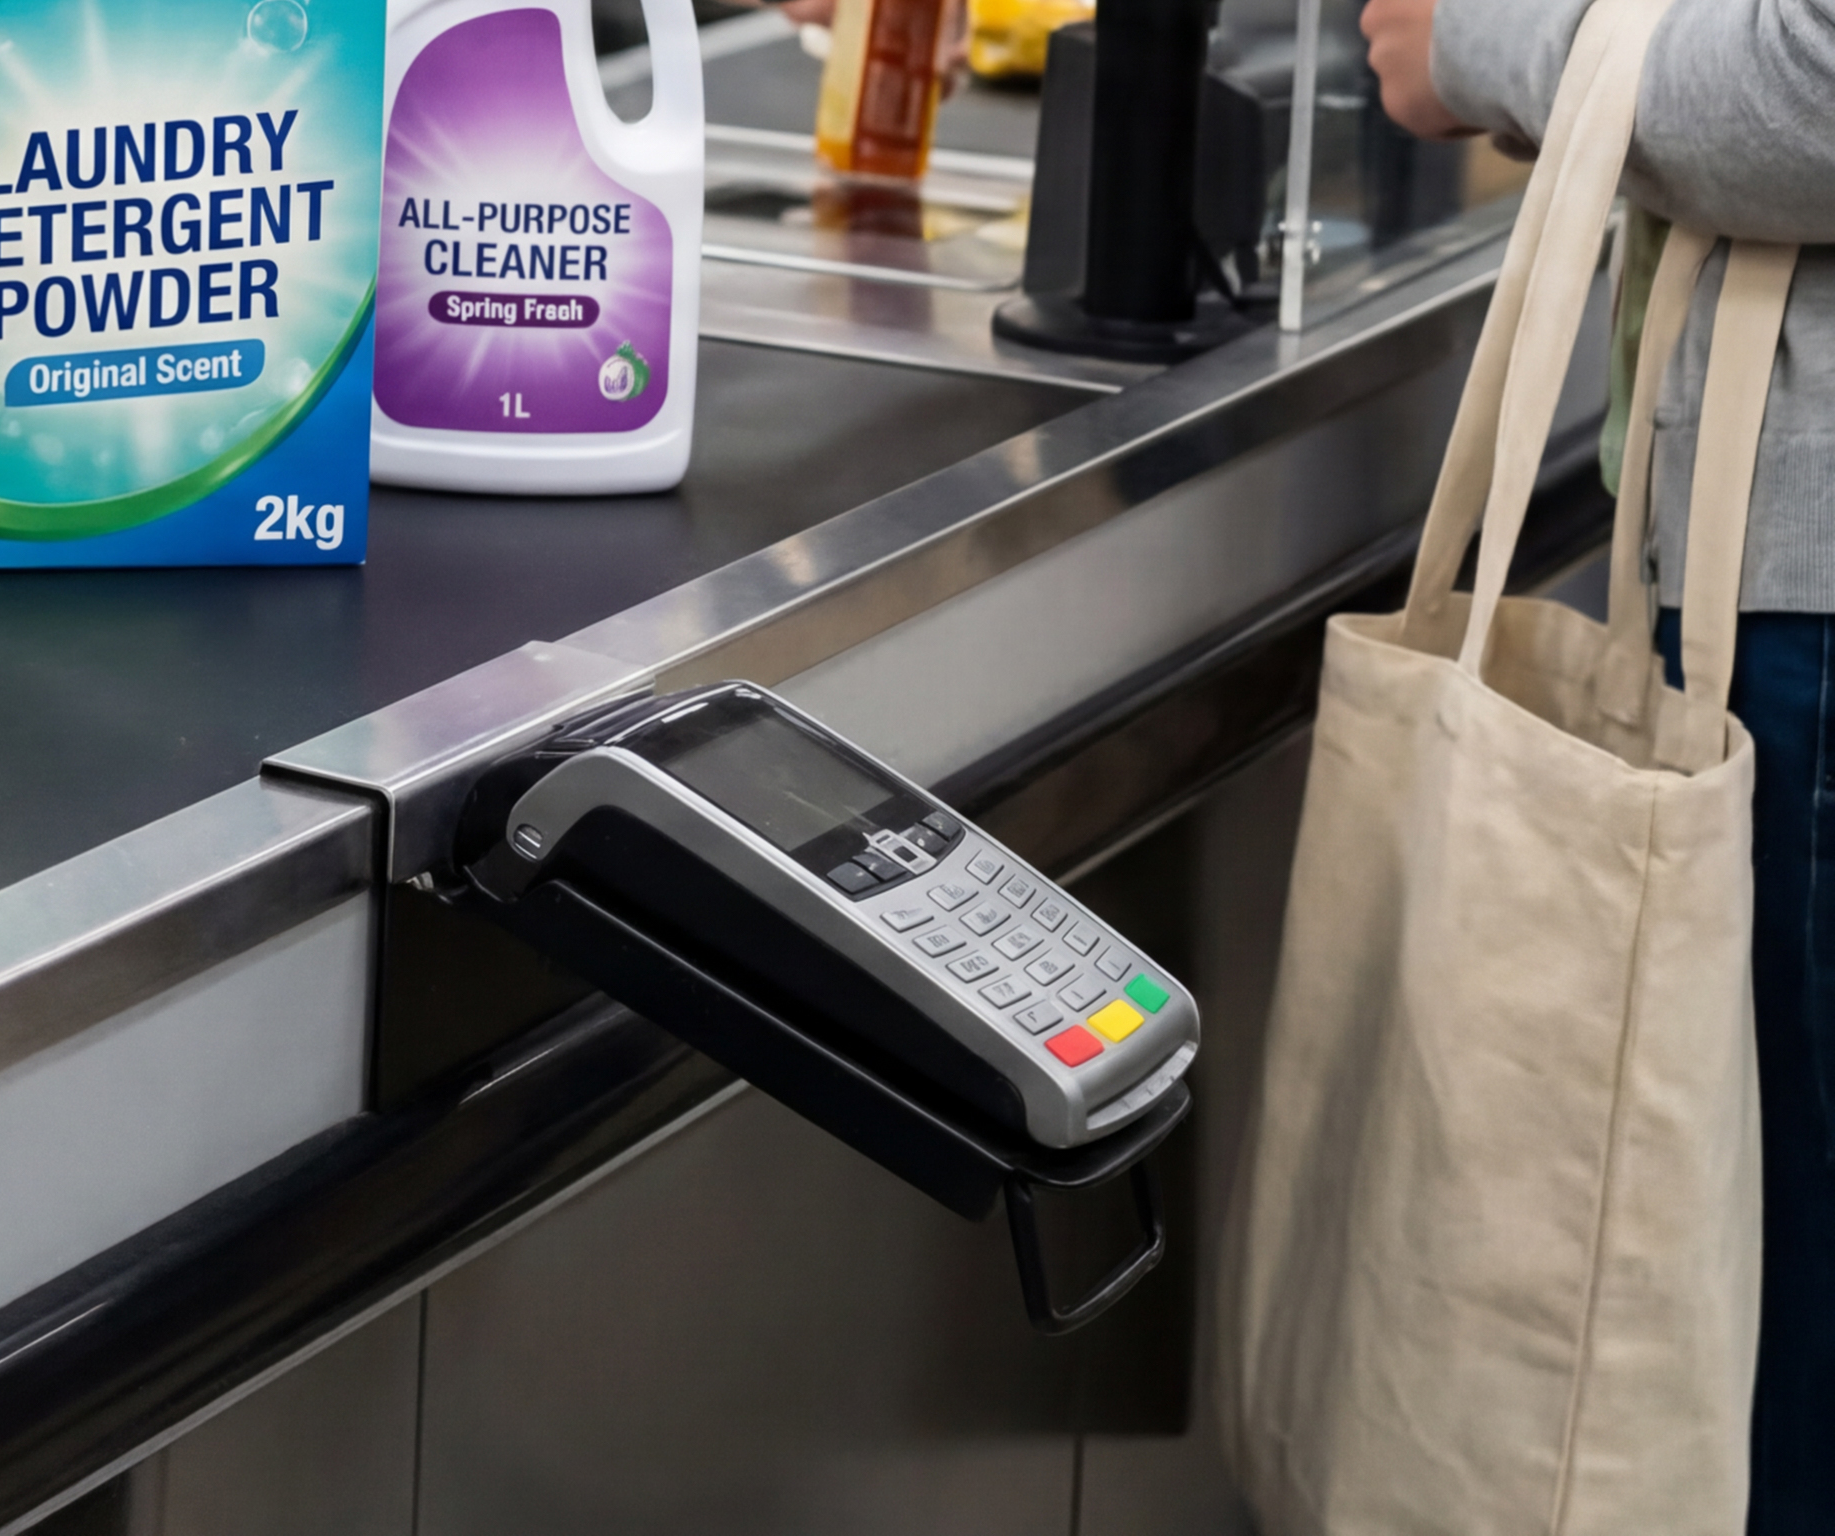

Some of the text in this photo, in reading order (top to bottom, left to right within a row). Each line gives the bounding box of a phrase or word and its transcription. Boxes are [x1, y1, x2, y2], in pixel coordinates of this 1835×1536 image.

[398, 197, 631, 234] ALL-PURPOSE
[424, 239, 608, 281] CLEANER
[446, 295, 517, 325] Spring
[29, 349, 242, 396] Original Scent
[254, 495, 345, 550] 2kg
